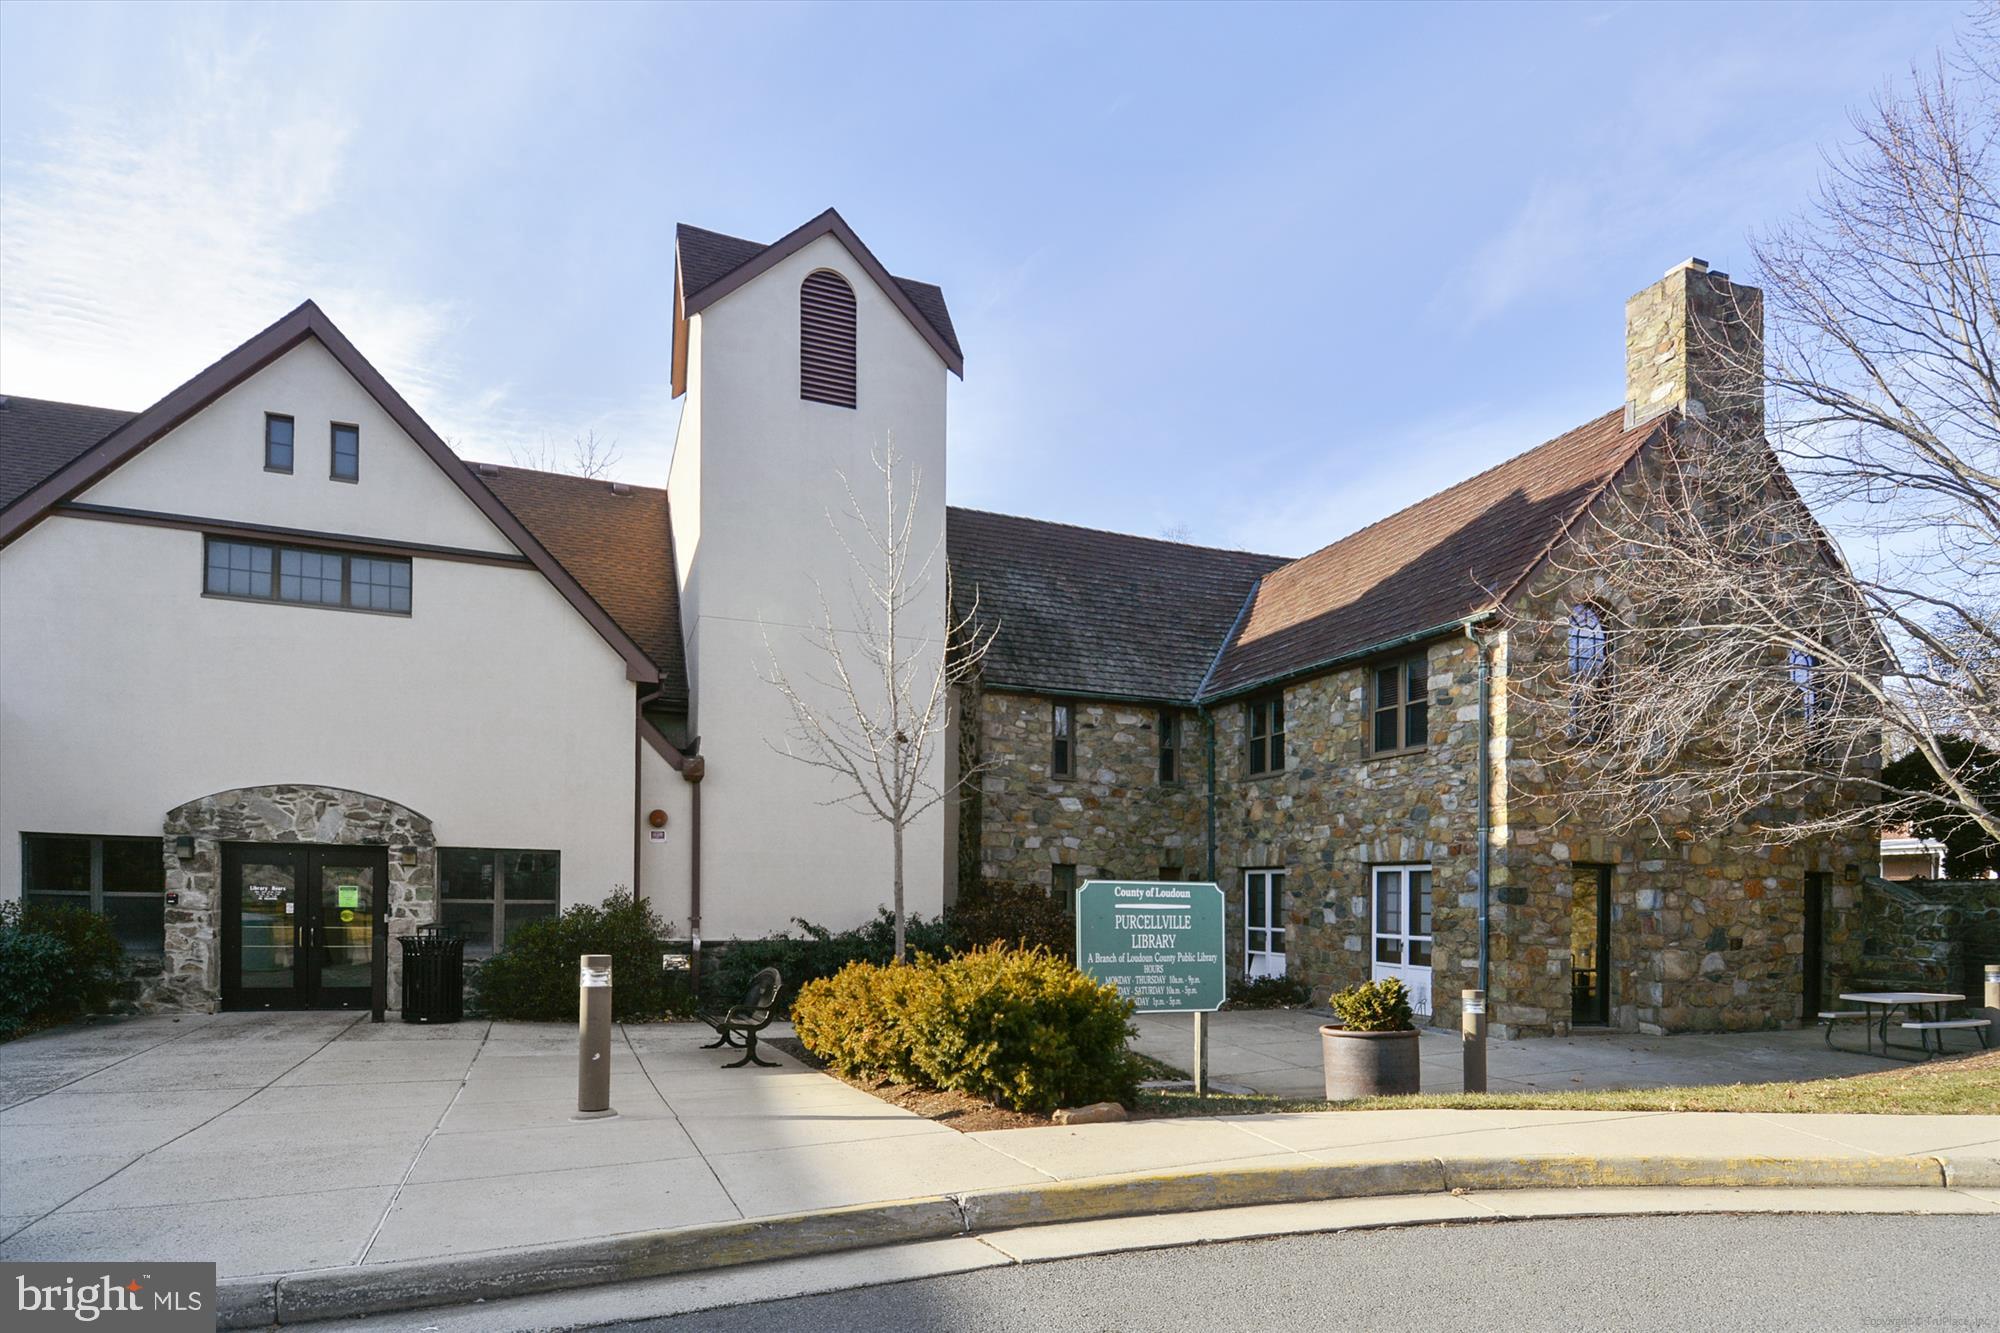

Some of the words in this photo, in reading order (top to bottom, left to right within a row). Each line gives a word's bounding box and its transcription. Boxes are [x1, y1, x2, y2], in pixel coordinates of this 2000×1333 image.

[1114, 886, 1144, 900] County
[1145, 887, 1155, 897] of
[1155, 887, 1191, 898] Loudoun
[1115, 915, 1191, 929] PURCELLVILLE
[1131, 934, 1176, 949] LIBRARY
[1087, 953, 1093, 963] A
[1095, 953, 1117, 963] Branch
[1118, 953, 1125, 963] of
[1126, 953, 1154, 963] Loudoun
[1154, 953, 1176, 964] County
[1177, 952, 1196, 962] Public
[1197, 952, 1217, 964] Library
[1144, 965, 1164, 973] HOURS
[1135, 975, 1166, 985] THURSDAY
[1134, 986, 1166, 995] SATURDAY
